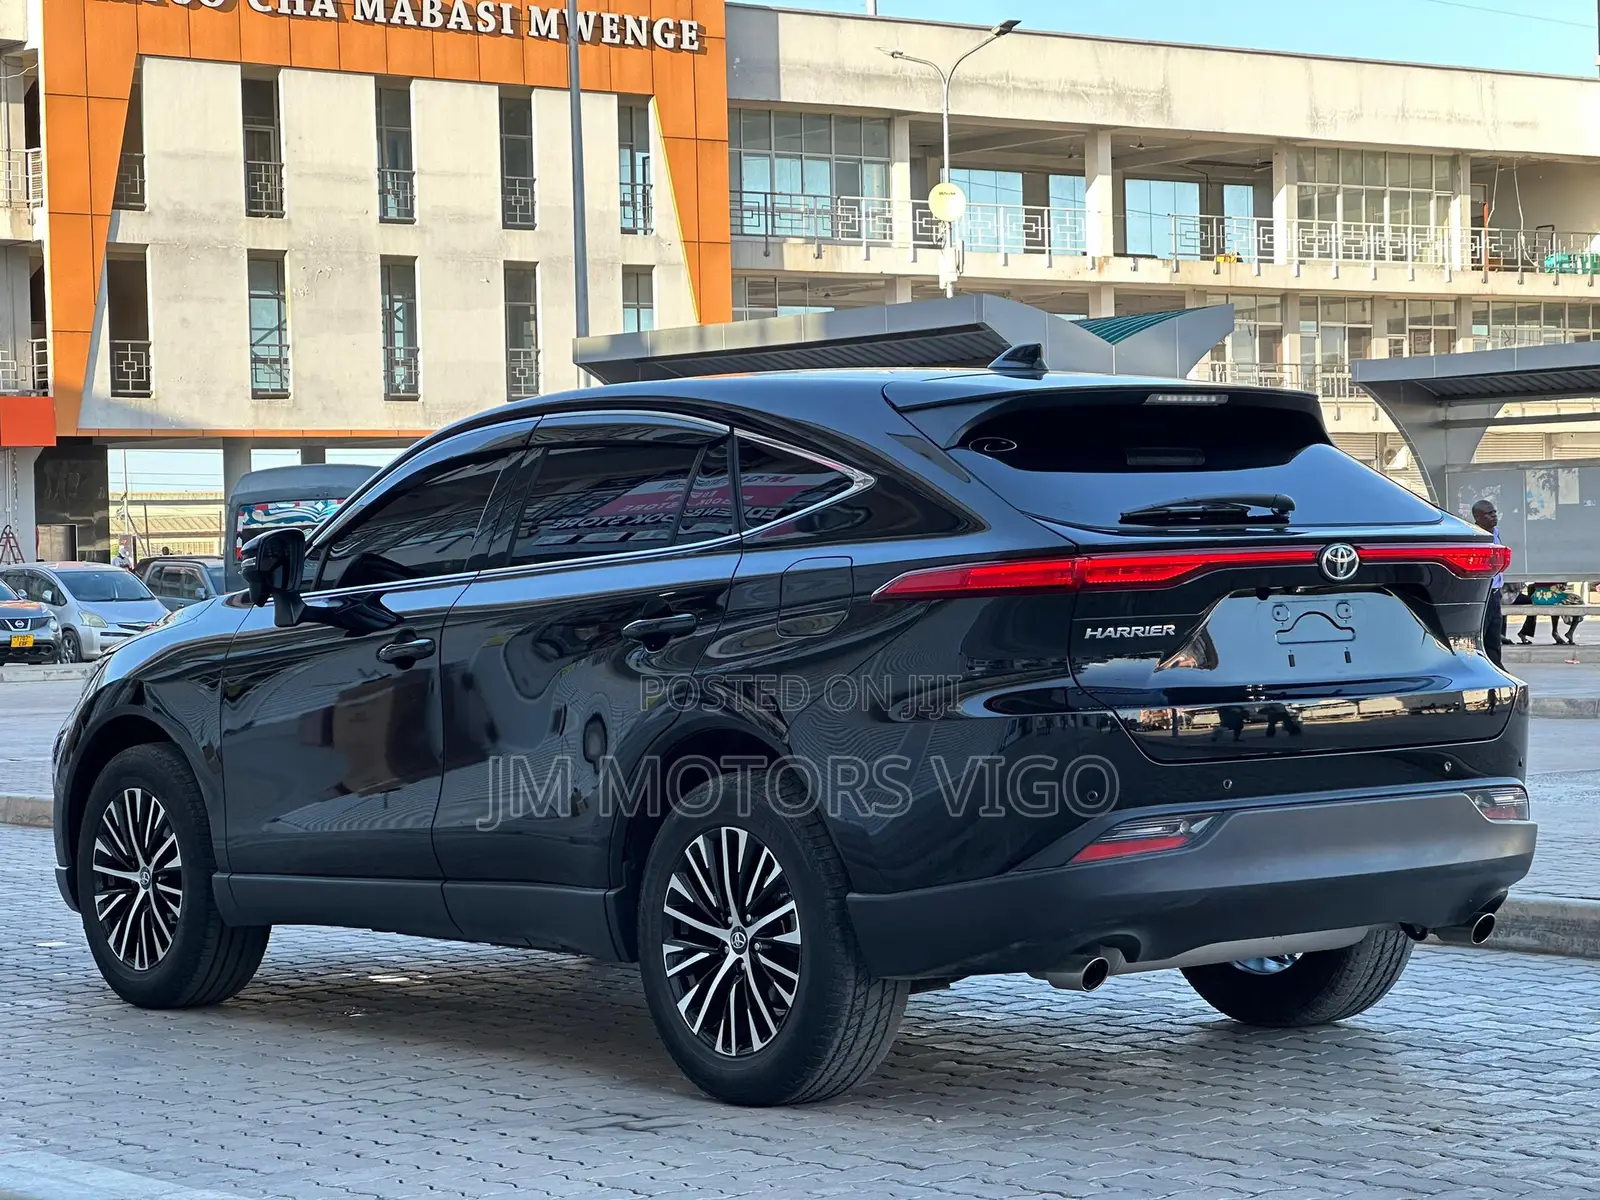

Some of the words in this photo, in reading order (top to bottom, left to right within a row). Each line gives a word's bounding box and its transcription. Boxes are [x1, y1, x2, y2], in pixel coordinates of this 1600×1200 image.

[351, 0, 514, 34] MABASI
[527, 5, 699, 50] MWENGE
[1084, 624, 1176, 640] HARRIER
